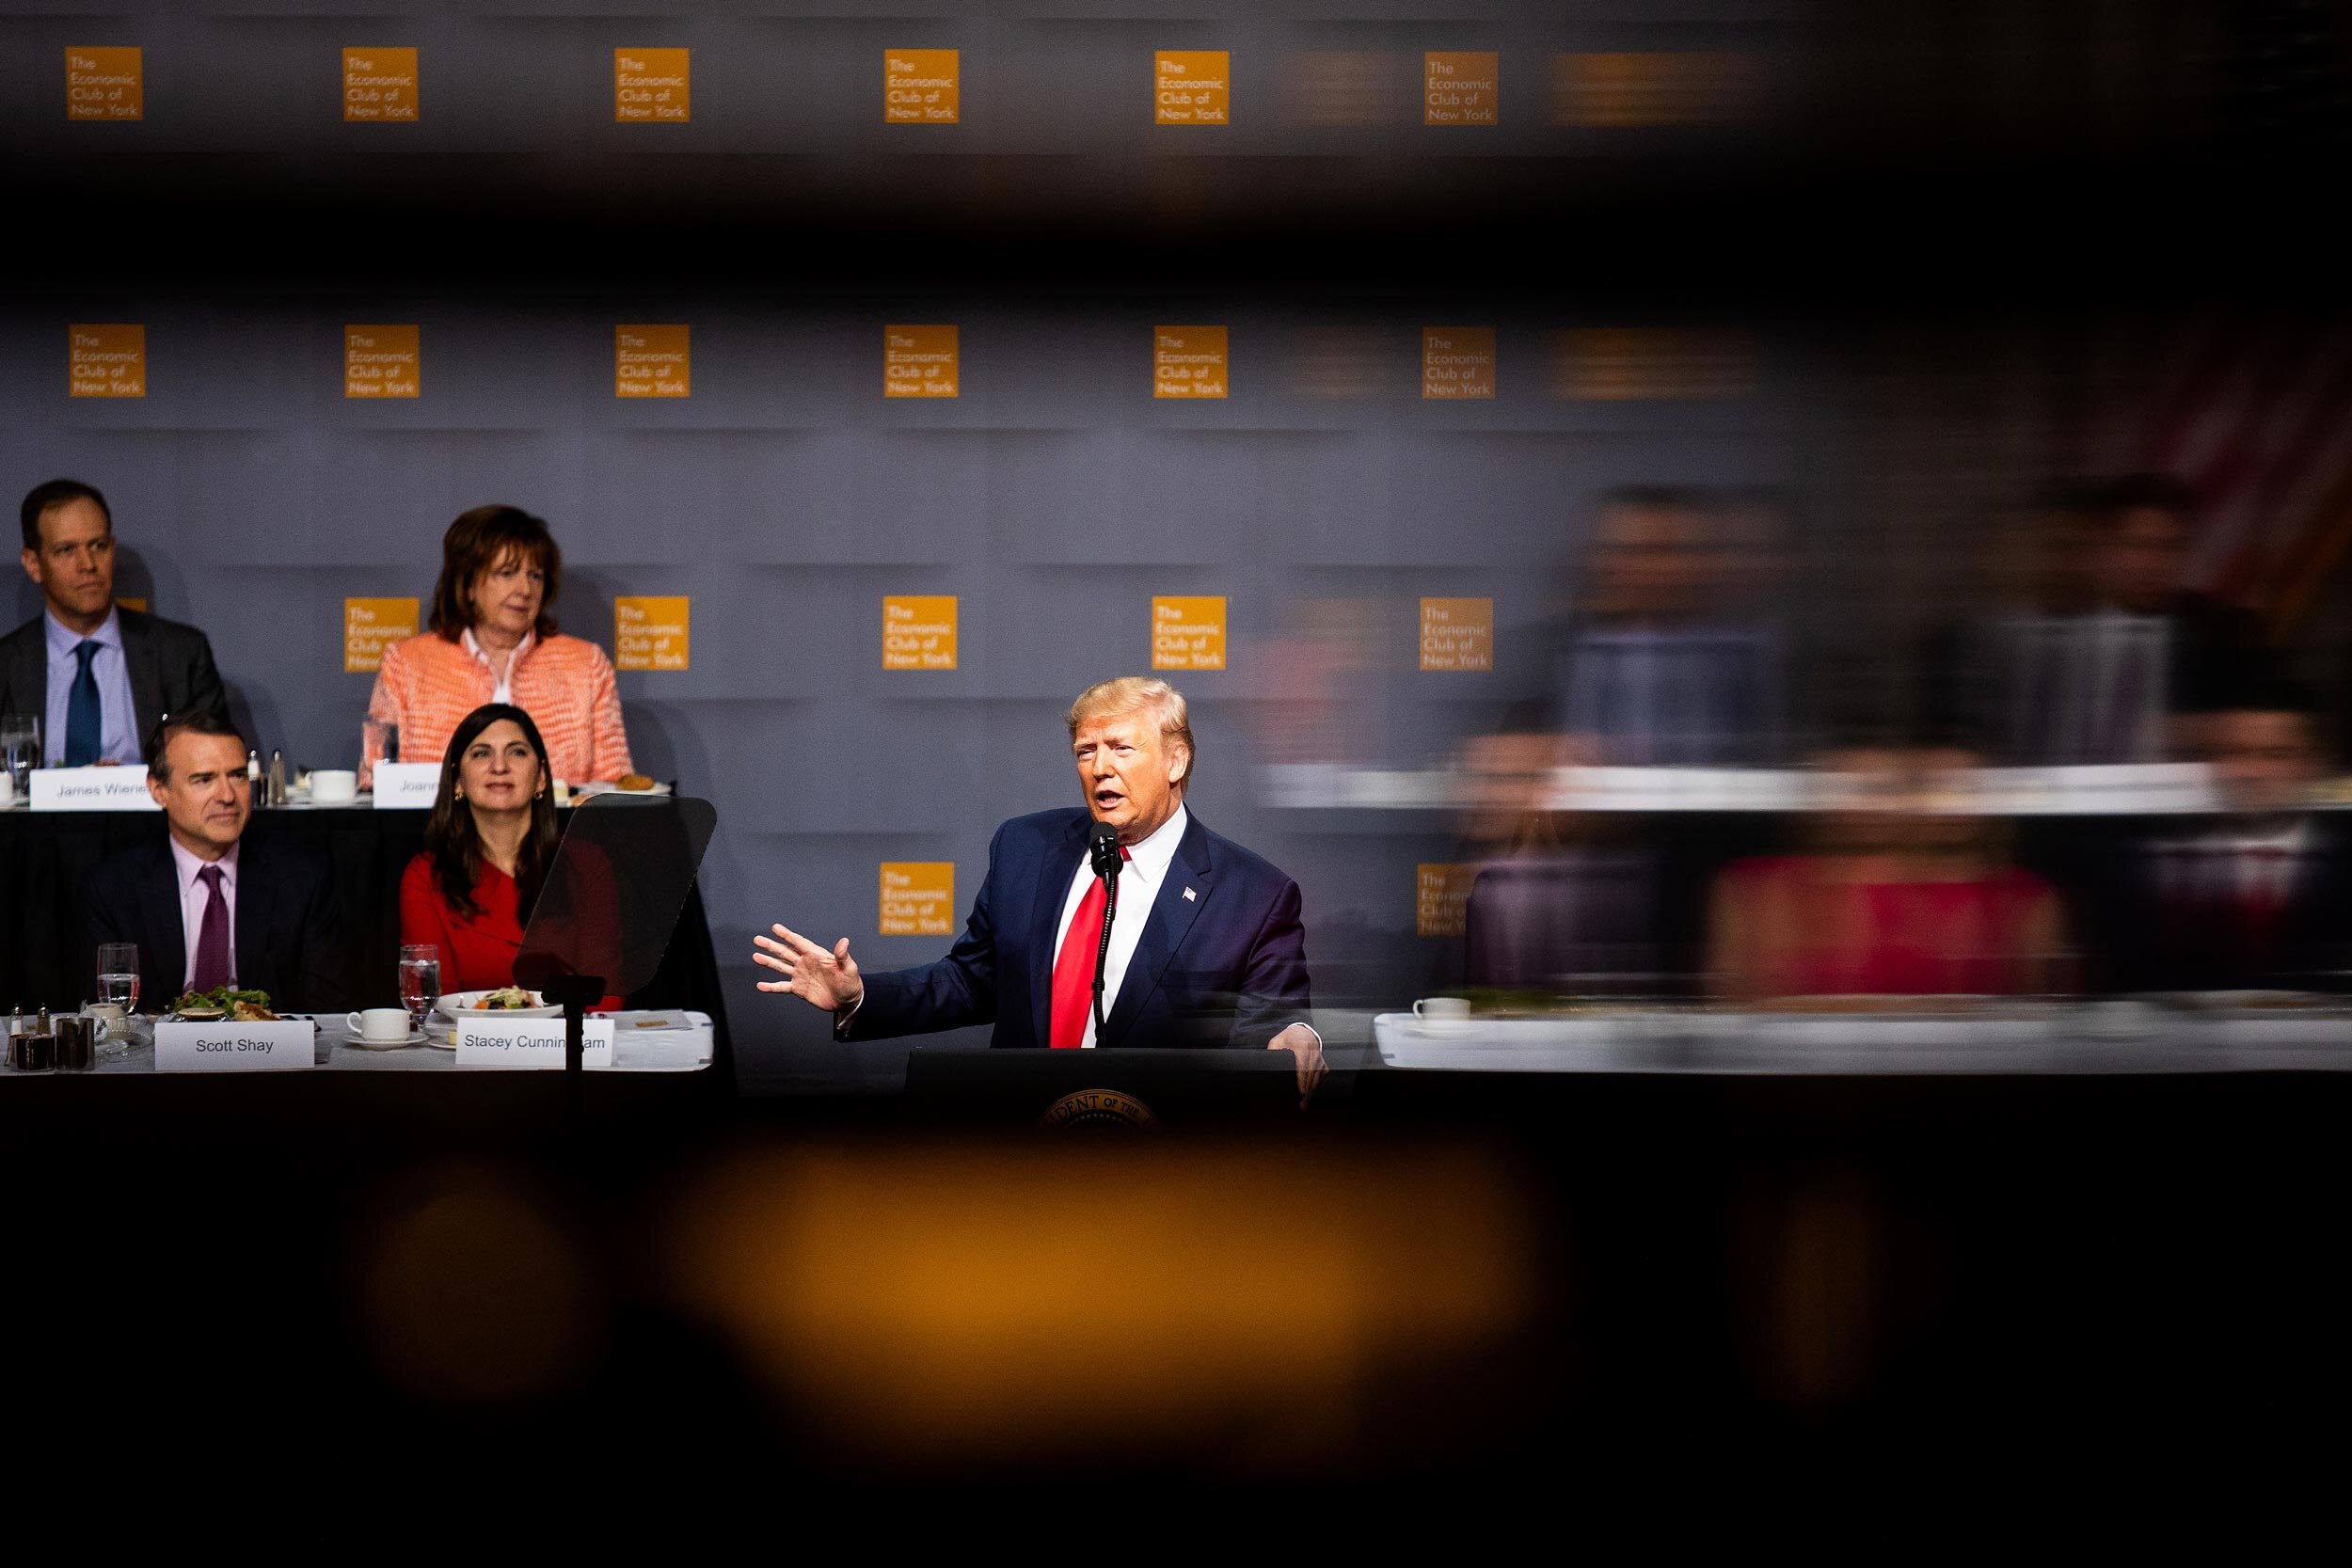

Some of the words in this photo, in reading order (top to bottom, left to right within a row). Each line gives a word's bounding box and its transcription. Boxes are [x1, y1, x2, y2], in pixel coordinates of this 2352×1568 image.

[71, 56, 96, 70] The
[348, 57, 373, 70] The
[620, 57, 644, 71] The
[889, 58, 914, 71] The
[1160, 60, 1184, 73] The
[1430, 62, 1454, 74] The
[72, 72, 135, 86] Economic
[348, 72, 412, 86] Economic
[620, 73, 683, 87] Economic
[889, 74, 952, 87] Economic
[1160, 76, 1223, 89] Economic
[1430, 77, 1492, 90] Economic
[72, 87, 103, 101] Club
[108, 87, 123, 101] of
[348, 88, 380, 102] Club
[385, 87, 399, 102] of
[620, 89, 651, 103] Club
[656, 88, 670, 103] of
[889, 90, 920, 103] Club
[925, 89, 939, 103] of
[1160, 92, 1191, 104] Club
[1196, 91, 1210, 104] of
[1430, 93, 1460, 105] Club
[1465, 92, 1479, 105] of
[72, 104, 103, 116] New
[107, 104, 137, 116] York
[348, 104, 379, 116] New
[384, 104, 413, 116] York
[620, 105, 650, 118] New
[655, 105, 684, 118] York
[889, 106, 919, 118] New
[924, 106, 953, 118] York
[1160, 108, 1190, 119] New
[1195, 108, 1224, 119] York
[1429, 109, 1459, 120] New
[1464, 109, 1493, 120] York
[74, 334, 100, 347] The
[350, 334, 374, 347] The
[621, 335, 645, 347] The
[889, 334, 914, 347] The
[1159, 335, 1184, 348] The
[1427, 337, 1452, 349] The
[75, 350, 139, 363] Economic
[350, 350, 413, 363] Economic
[621, 350, 684, 363] Economic
[889, 350, 952, 363] Economic
[1159, 351, 1221, 363] Economic
[1427, 352, 1488, 365] Economic
[75, 365, 106, 378] Club
[111, 365, 126, 378] of
[350, 365, 381, 378] Club
[386, 365, 400, 378] of
[621, 365, 652, 378] Club
[657, 365, 671, 378] of
[889, 365, 920, 378] Club
[925, 365, 939, 378] of
[1159, 366, 1190, 378] Club
[1195, 366, 1209, 378] of
[1427, 367, 1457, 379] Club
[1462, 367, 1476, 379] of
[75, 381, 105, 392] New
[110, 381, 140, 392] York
[350, 381, 381, 392] New
[386, 381, 415, 392] York
[621, 381, 651, 393] New
[656, 381, 685, 393] York
[889, 381, 920, 392] New
[924, 381, 953, 392] York
[1159, 382, 1189, 393] New
[1194, 382, 1223, 393] York
[1427, 383, 1457, 394] New
[1461, 383, 1490, 394] York
[350, 607, 374, 621] The
[620, 606, 644, 619] The
[888, 606, 913, 619] The
[1157, 606, 1181, 619] The
[1424, 607, 1449, 620] The
[348, 624, 412, 637] Economic
[620, 622, 682, 635] Economic
[888, 622, 951, 635] Economic
[1157, 622, 1219, 635] Economic
[1424, 623, 1486, 636] Economic
[348, 639, 382, 652] Club
[620, 638, 651, 650] Club
[656, 637, 670, 650] of
[888, 637, 919, 650] Club
[923, 637, 938, 650] of
[1157, 637, 1188, 650] Club
[1192, 637, 1207, 650] of
[1424, 638, 1455, 651] Club
[1460, 638, 1474, 651] of
[620, 654, 650, 665] New
[655, 654, 683, 665] York
[887, 653, 918, 665] New
[923, 653, 951, 665] York
[1156, 653, 1187, 665] New
[1192, 653, 1221, 665] York
[1424, 654, 1454, 666] New
[1459, 654, 1488, 666] York
[58, 784, 101, 798] James
[105, 783, 147, 796] Wiene
[885, 872, 909, 884] The
[1422, 874, 1446, 886] The
[885, 887, 947, 900] Economic
[885, 903, 915, 915] Club
[920, 902, 934, 915] of
[1422, 904, 1453, 916] Club
[884, 918, 914, 930] New
[919, 918, 948, 930] York
[1422, 920, 1452, 931] New
[196, 1039, 232, 1052] Scott
[237, 1038, 274, 1053] Shay
[465, 1035, 513, 1049] Stacey
[517, 1036, 605, 1048] Cunninam
[1104, 1098, 1118, 1108] OF
[1121, 1101, 1139, 1116] THE
